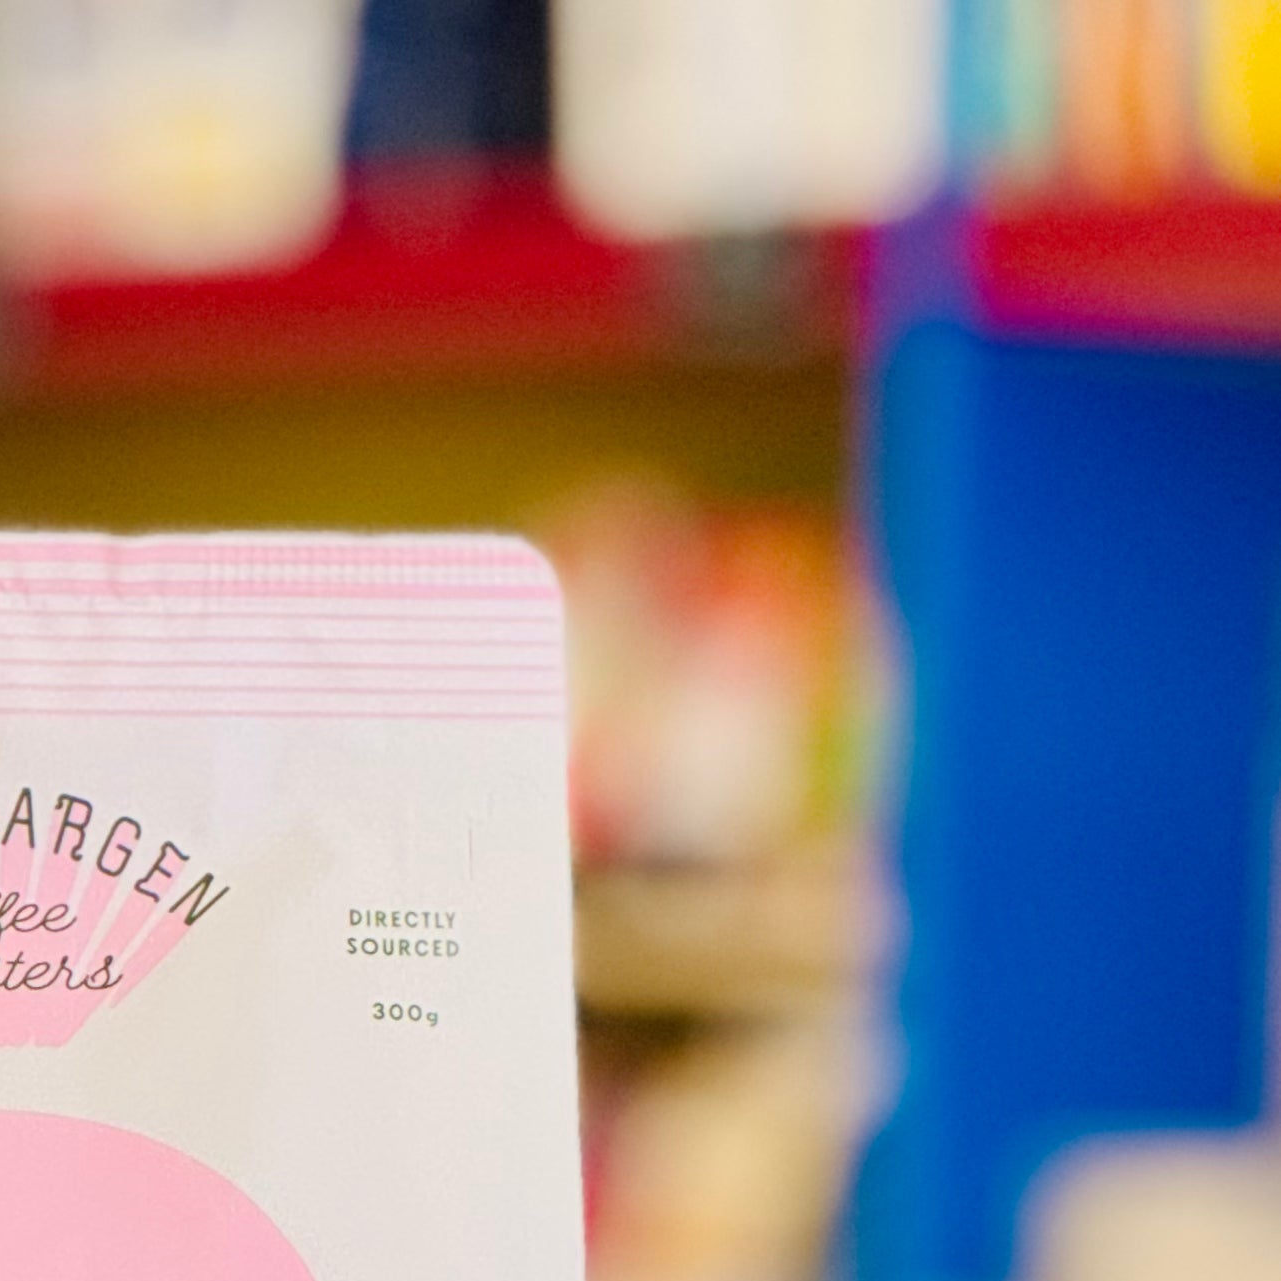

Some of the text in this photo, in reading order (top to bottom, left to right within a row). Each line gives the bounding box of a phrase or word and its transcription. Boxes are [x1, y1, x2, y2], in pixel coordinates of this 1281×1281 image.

[348, 907, 458, 931] DIRECTLY
[346, 935, 461, 959] SOURCED
[371, 1003, 440, 1029] 300g
